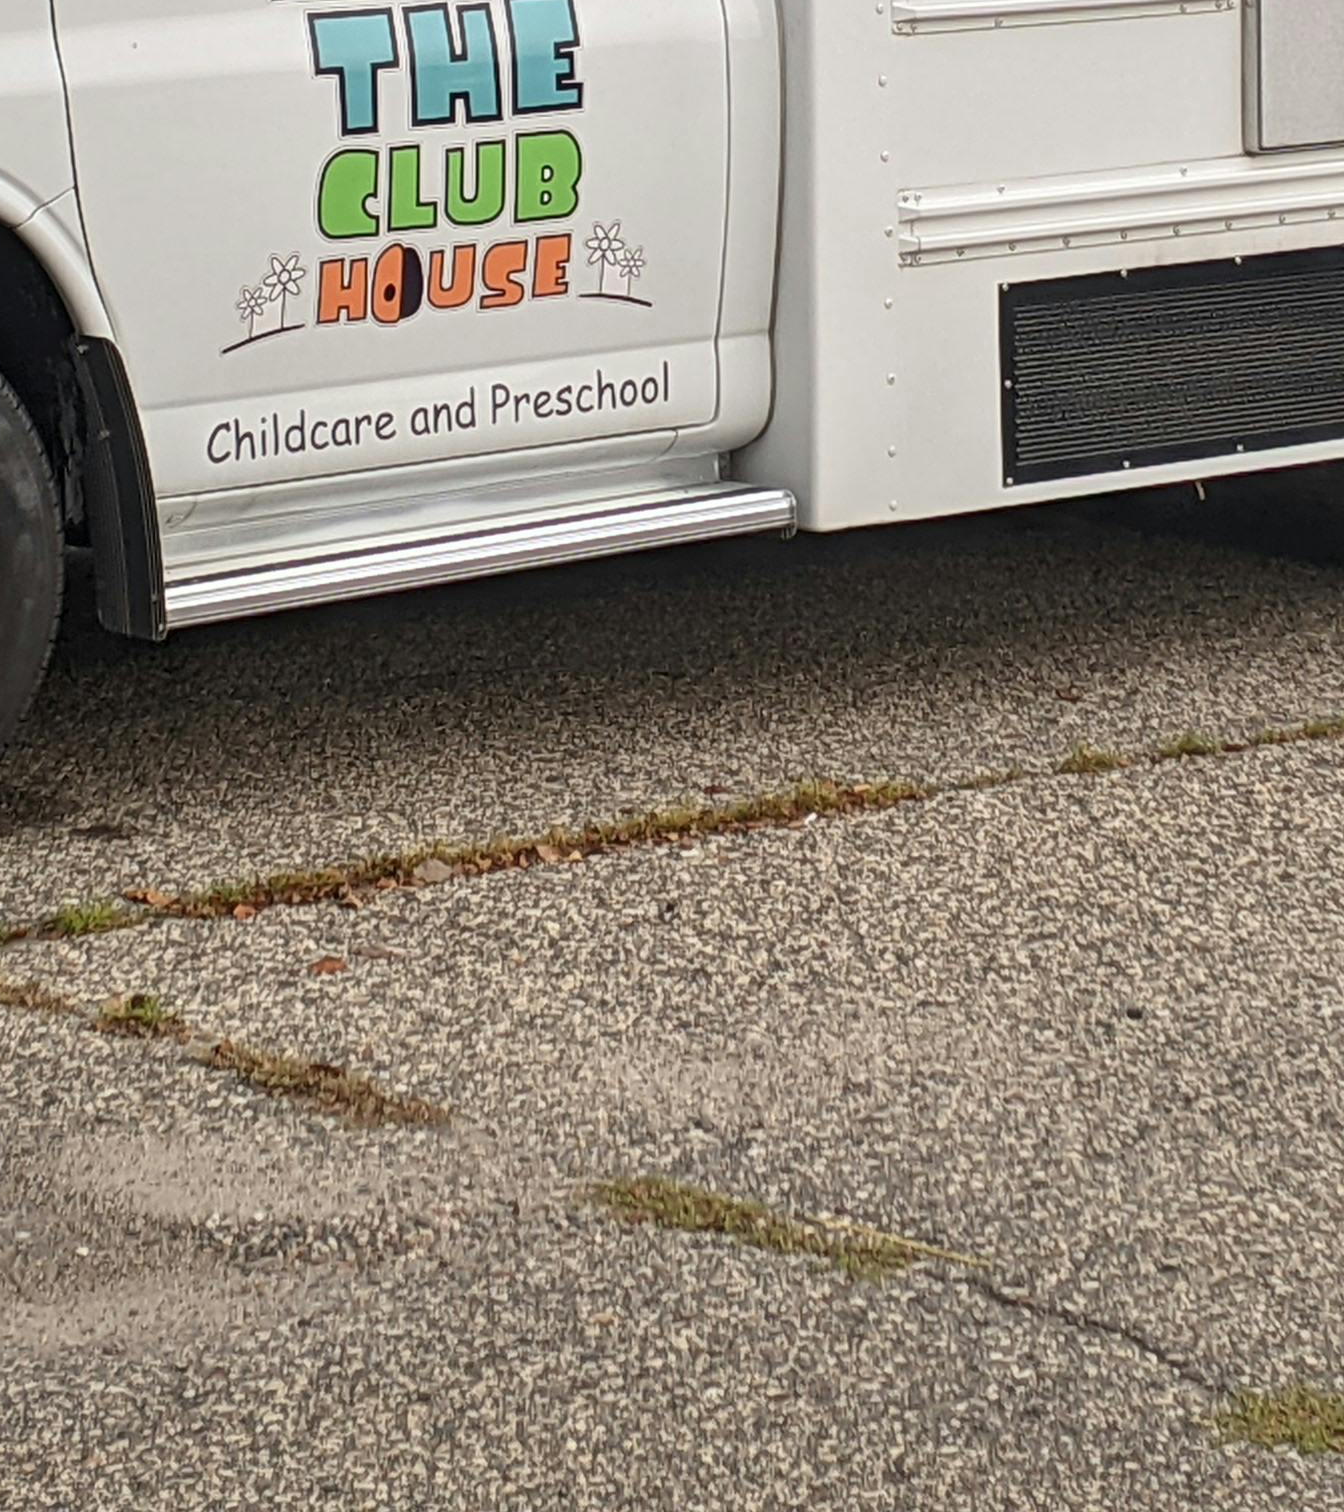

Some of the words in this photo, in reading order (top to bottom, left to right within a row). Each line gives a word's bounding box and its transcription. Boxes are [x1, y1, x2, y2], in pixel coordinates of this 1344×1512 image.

[317, 130, 582, 240] CLUB
[315, 234, 572, 325] HOUSE
[206, 408, 398, 465] Childcare
[409, 386, 477, 437] and
[490, 360, 672, 425] Preschool
